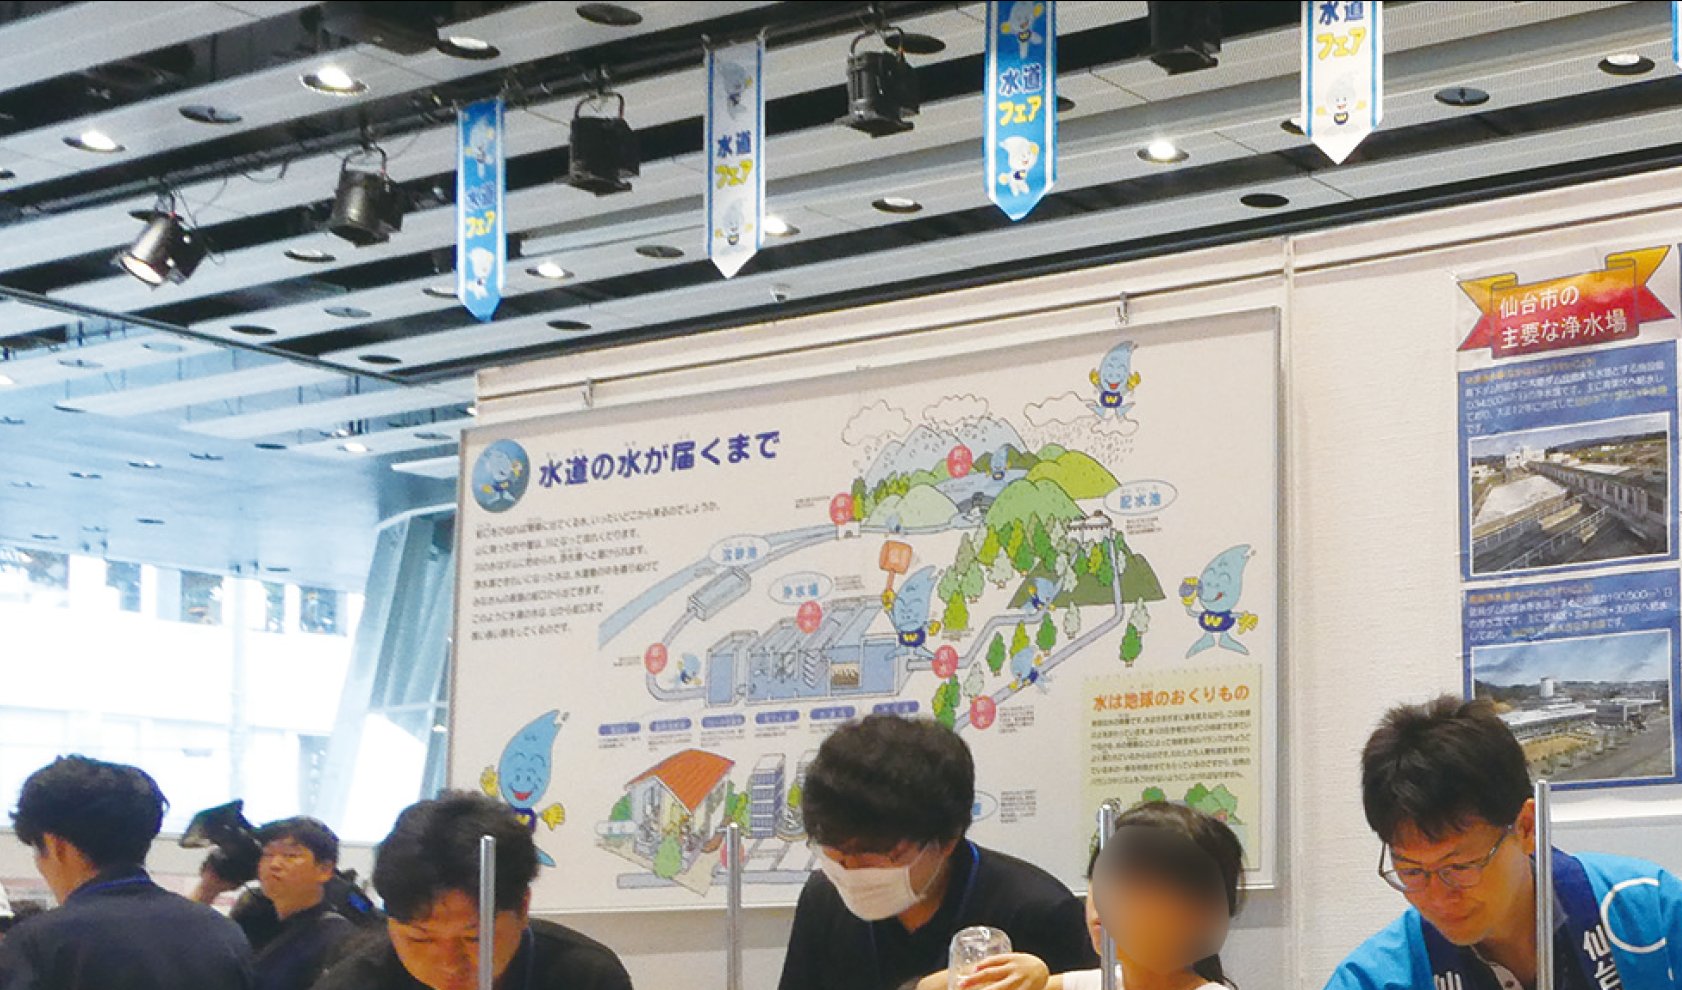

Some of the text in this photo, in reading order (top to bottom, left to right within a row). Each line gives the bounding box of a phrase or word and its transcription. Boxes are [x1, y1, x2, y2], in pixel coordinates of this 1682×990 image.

[1316, 28, 1368, 60] フェア
[1000, 62, 1042, 95] 水道
[998, 97, 1042, 126] フェア
[716, 130, 752, 158] 水道
[715, 159, 754, 189] フェア
[464, 213, 497, 238] フェア
[1499, 285, 1580, 319] 仙台市の
[1500, 307, 1629, 350] 主要な浄水場
[539, 430, 781, 488] 水道の水が届くまで
[1092, 683, 1250, 713] 水は地球のおくりもの
